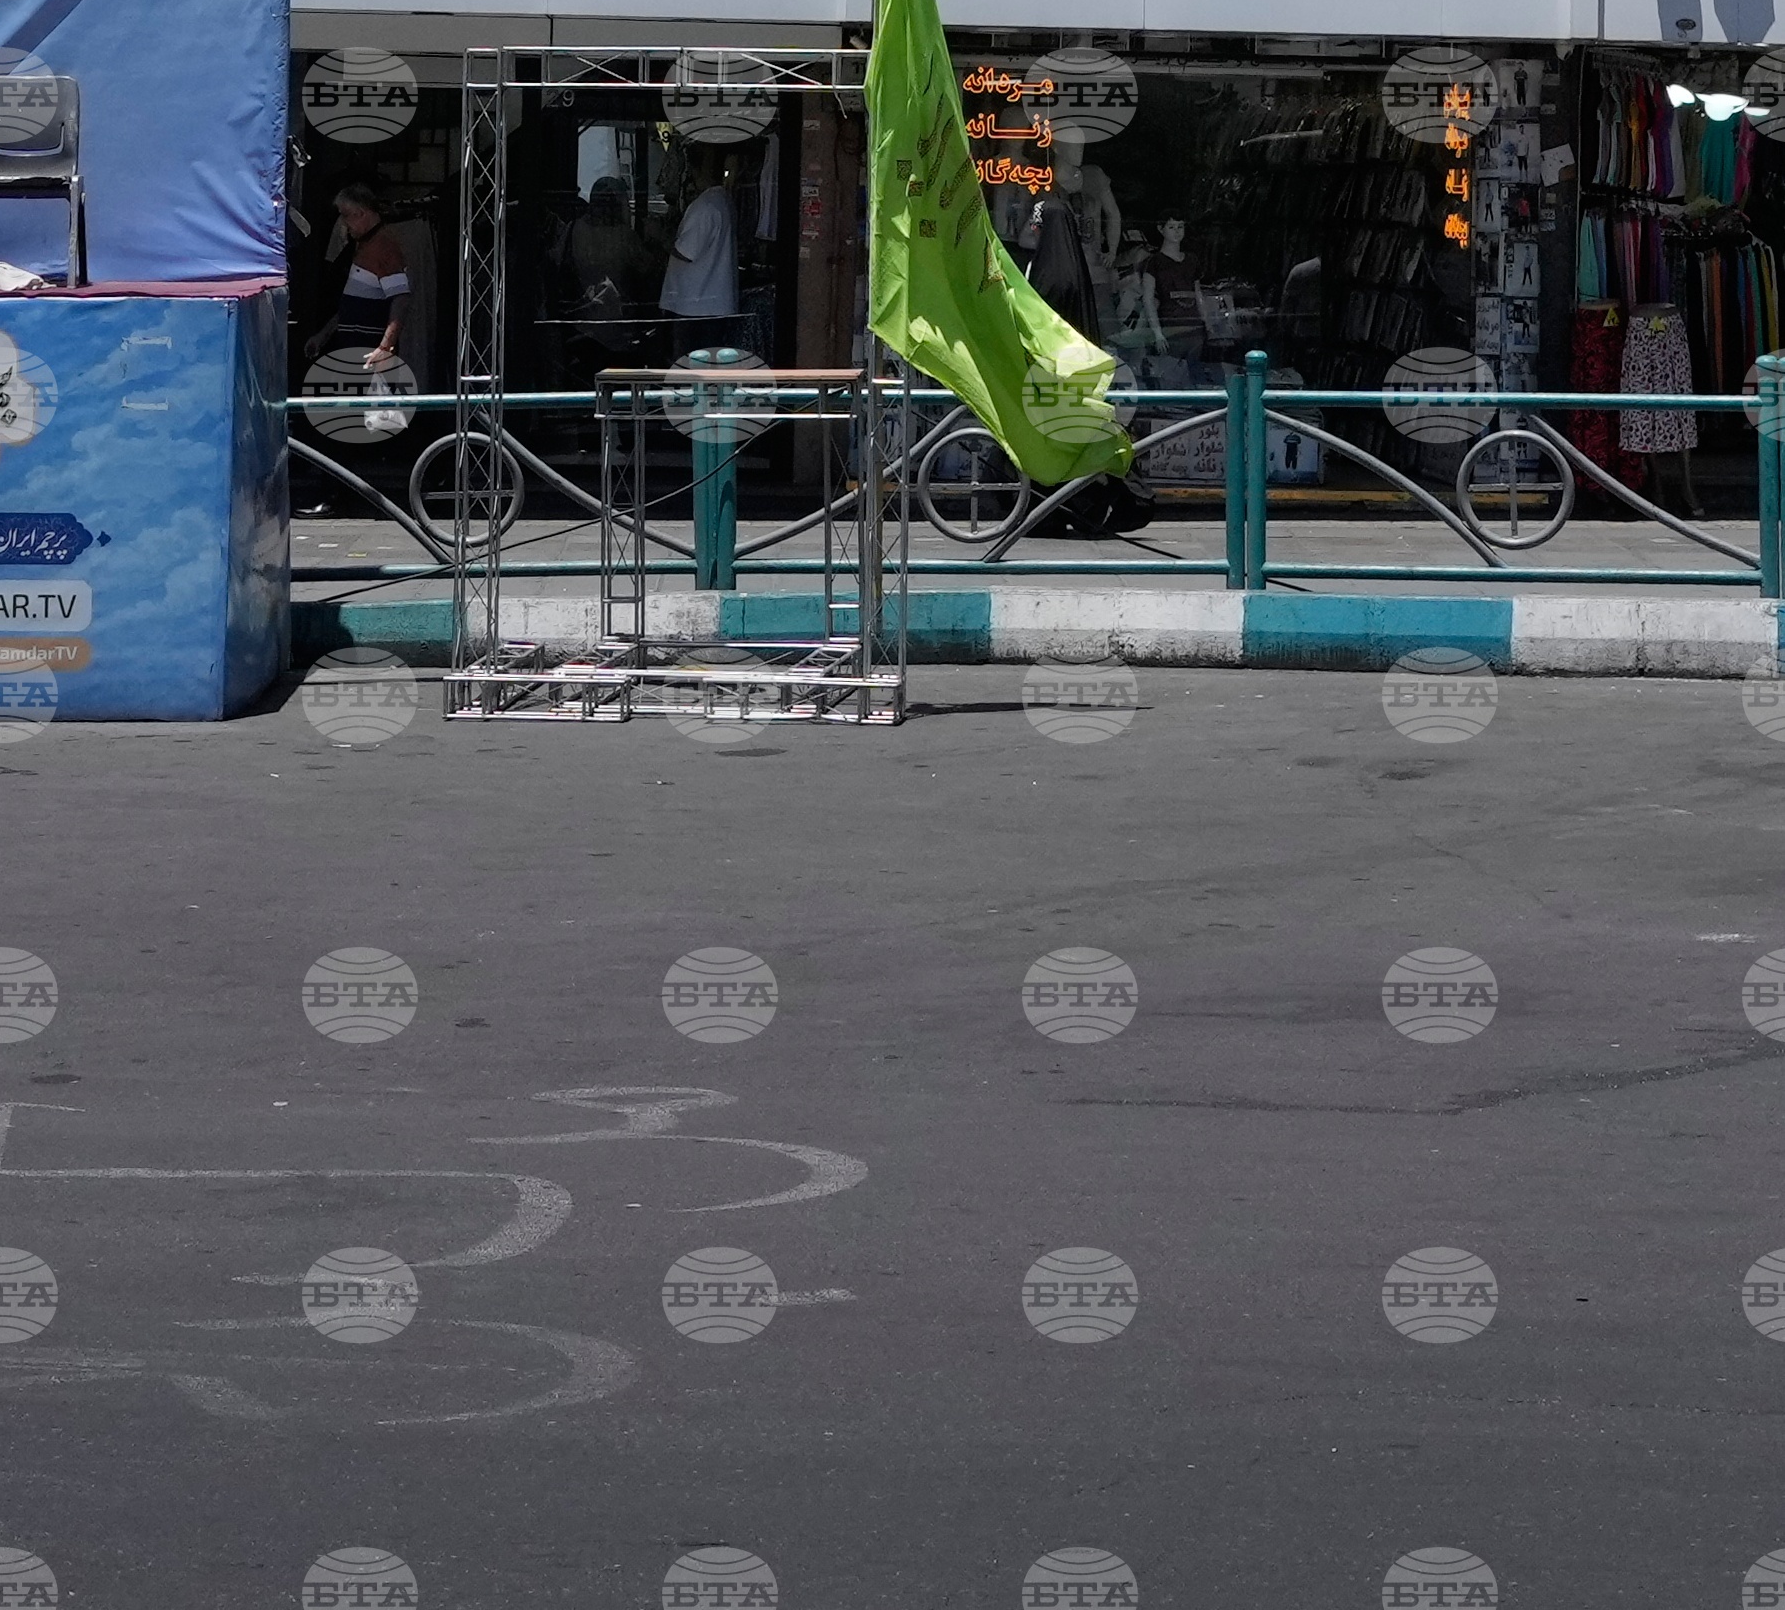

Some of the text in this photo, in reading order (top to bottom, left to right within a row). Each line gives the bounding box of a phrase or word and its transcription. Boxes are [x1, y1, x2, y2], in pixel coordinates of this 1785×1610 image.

[962, 66, 1054, 102] مردانه
[964, 113, 1053, 148] زنانه
[37, 528, 68, 560] پرچم
